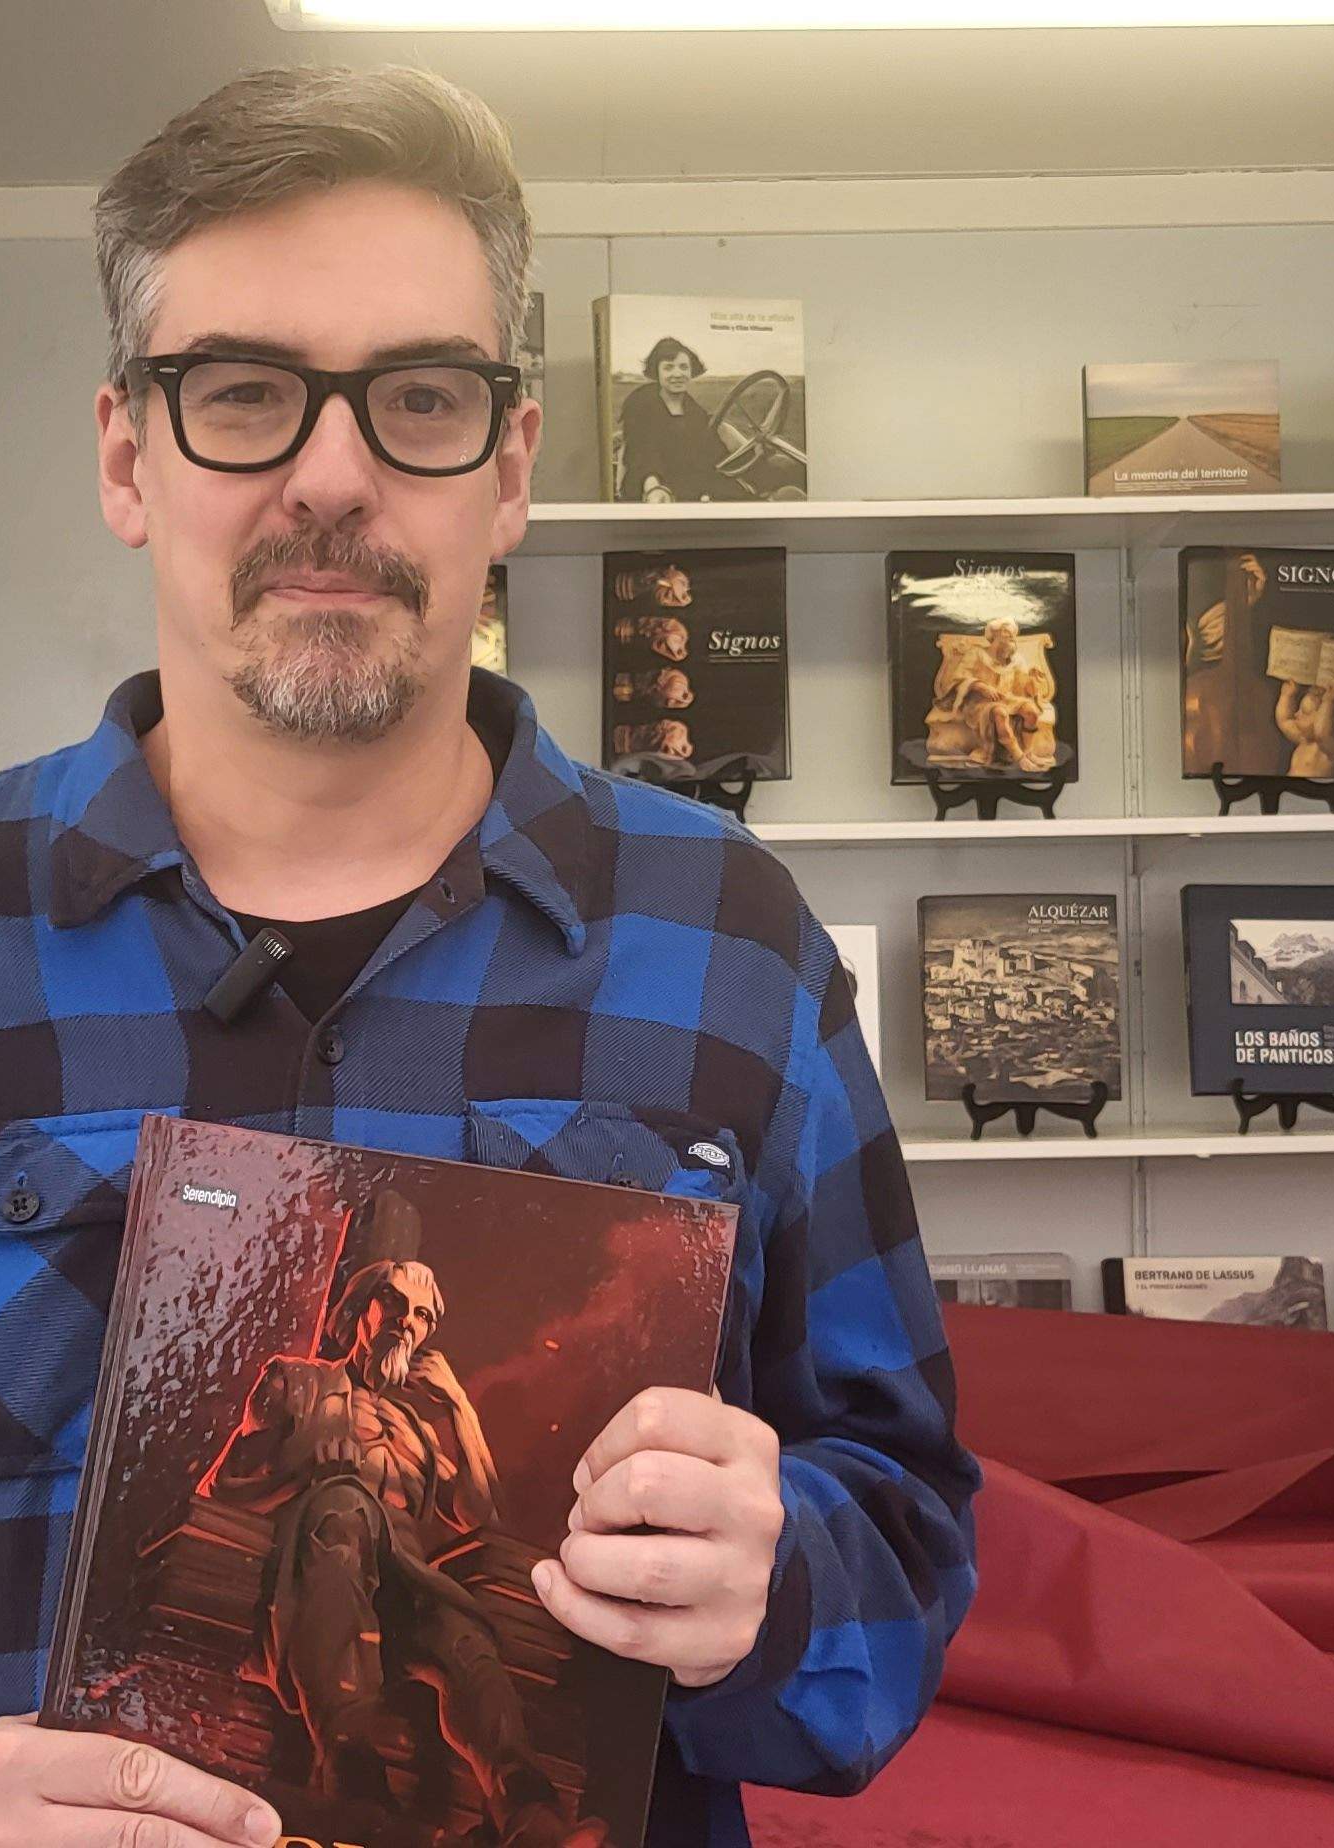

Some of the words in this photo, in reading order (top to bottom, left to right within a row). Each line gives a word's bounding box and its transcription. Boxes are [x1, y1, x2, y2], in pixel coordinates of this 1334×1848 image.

[1114, 471, 1128, 481] La
[1131, 470, 1178, 480] memoria
[1181, 468, 1198, 479] del
[1200, 467, 1248, 479] territorio
[708, 630, 781, 655] Signos
[1028, 902, 1108, 920] ALQUÉZAR
[1235, 1031, 1264, 1047] LOS
[1269, 1028, 1319, 1047] BAÑOS
[1236, 1049, 1255, 1063] DE
[182, 1184, 237, 1208] Serendipia
[1134, 1270, 1193, 1280] BERTRAND
[1196, 1270, 1210, 1280] DE
[1213, 1270, 1255, 1280] LASSUS
